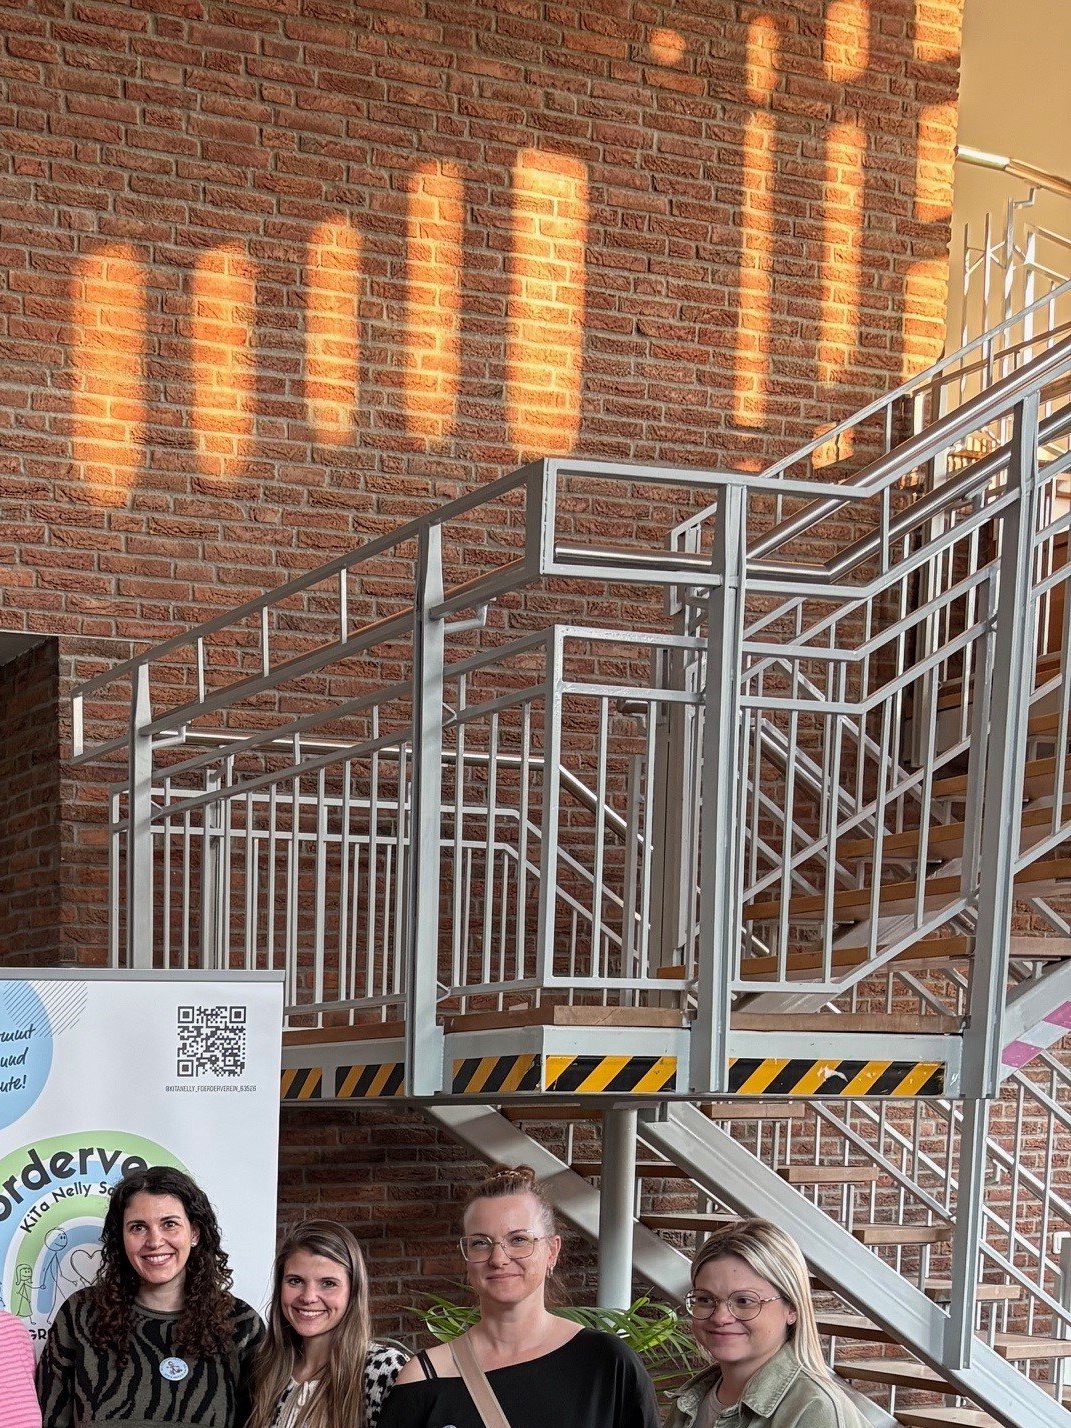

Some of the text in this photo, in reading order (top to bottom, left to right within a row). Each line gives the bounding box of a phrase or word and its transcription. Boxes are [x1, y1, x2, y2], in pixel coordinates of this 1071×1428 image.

[0, 1046, 29, 1067] und
[20, 1201, 51, 1233] KiTa
[52, 1181, 92, 1204] Nelly
